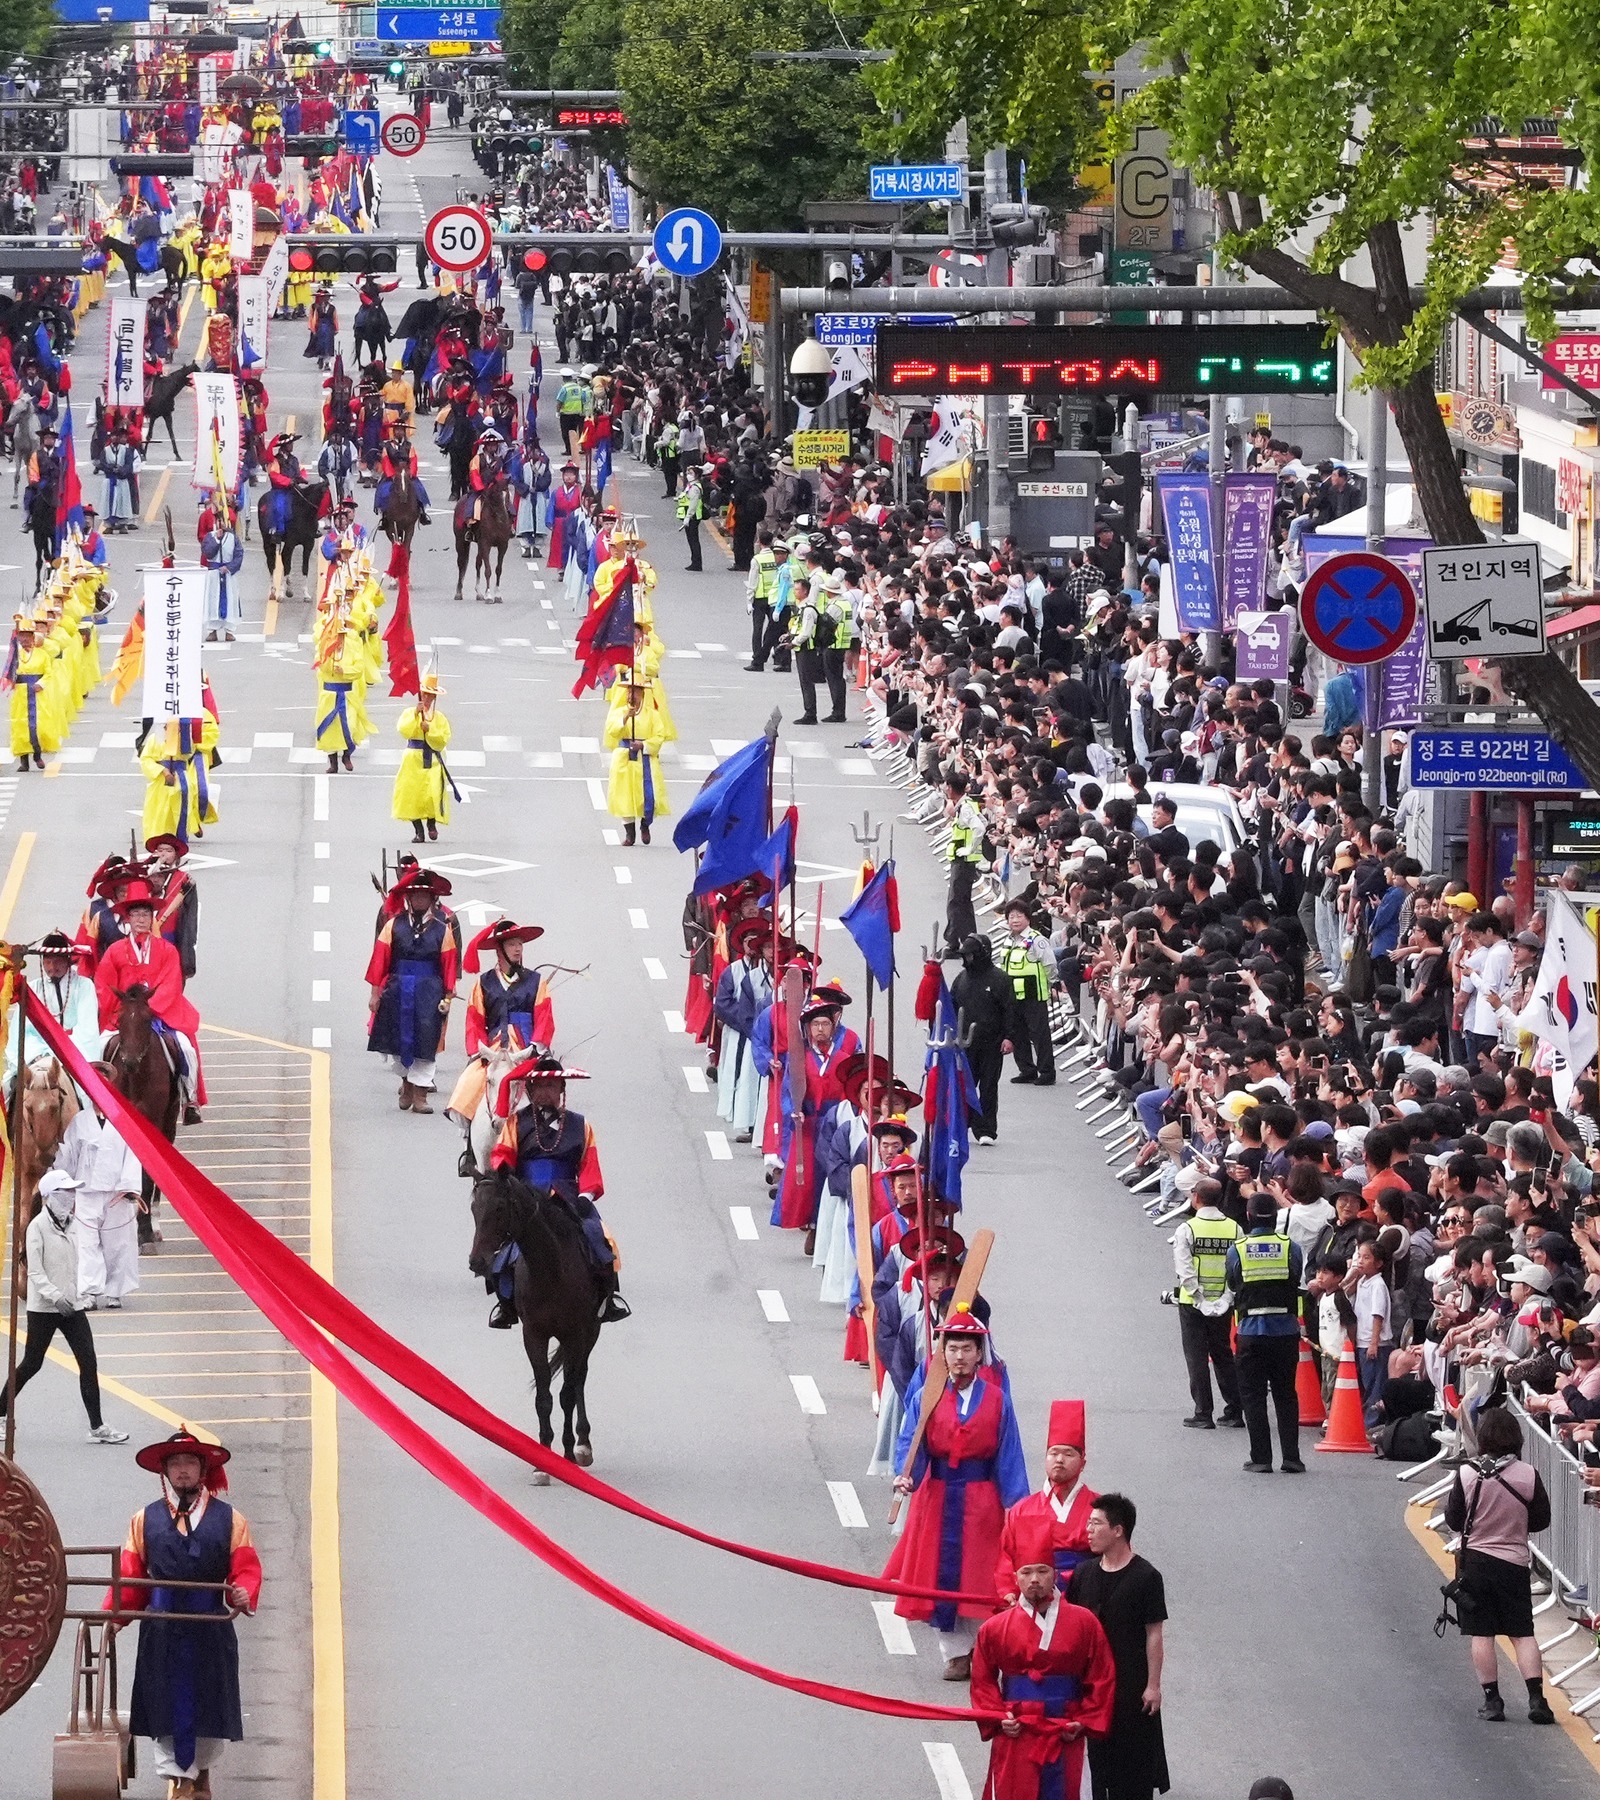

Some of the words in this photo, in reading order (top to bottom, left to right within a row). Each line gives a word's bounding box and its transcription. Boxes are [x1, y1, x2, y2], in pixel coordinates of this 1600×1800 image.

[439, 12, 477, 26] 수성로
[438, 27, 478, 37] Suseong-ro
[391, 126, 416, 144] 50
[874, 172, 959, 192] 거북시장사거리
[440, 226, 477, 251] 50
[1129, 226, 1159, 246] 2F
[1465, 403, 1503, 422] COMPOSE
[1466, 427, 1500, 444] COFFEE
[1021, 484, 1040, 494] 구두
[1178, 518, 1201, 532] 수원
[1179, 534, 1201, 549] 화성
[1176, 550, 1209, 565] 문화제
[1437, 559, 1531, 583] 견인지역
[164, 576, 183, 715] 수원문화원취타대
[1262, 662, 1278, 670] STOP
[1417, 769, 1475, 784] Jeongjo-ro
[1478, 769, 1545, 784] 922beon-gil
[1547, 771, 1568, 785] (Rd)
